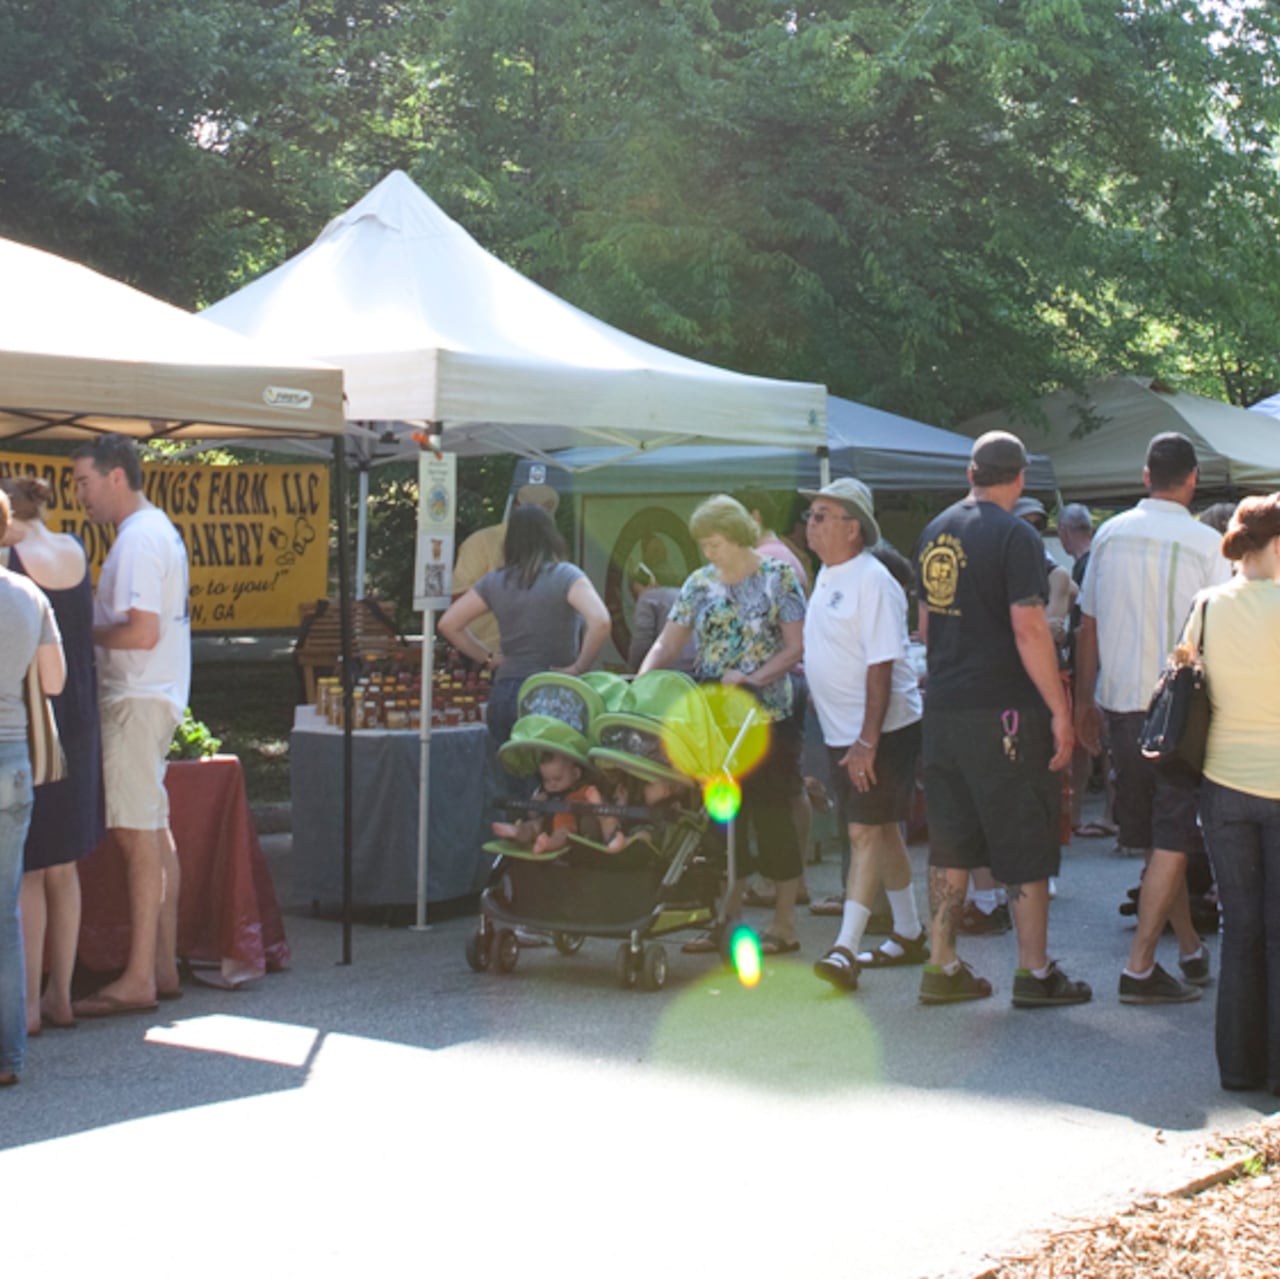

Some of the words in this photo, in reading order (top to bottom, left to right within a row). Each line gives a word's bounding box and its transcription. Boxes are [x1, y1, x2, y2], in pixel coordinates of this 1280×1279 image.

[208, 471, 277, 518] FARM,
[282, 472, 320, 515] LLC
[206, 578, 229, 596] to
[213, 603, 235, 620] GA
